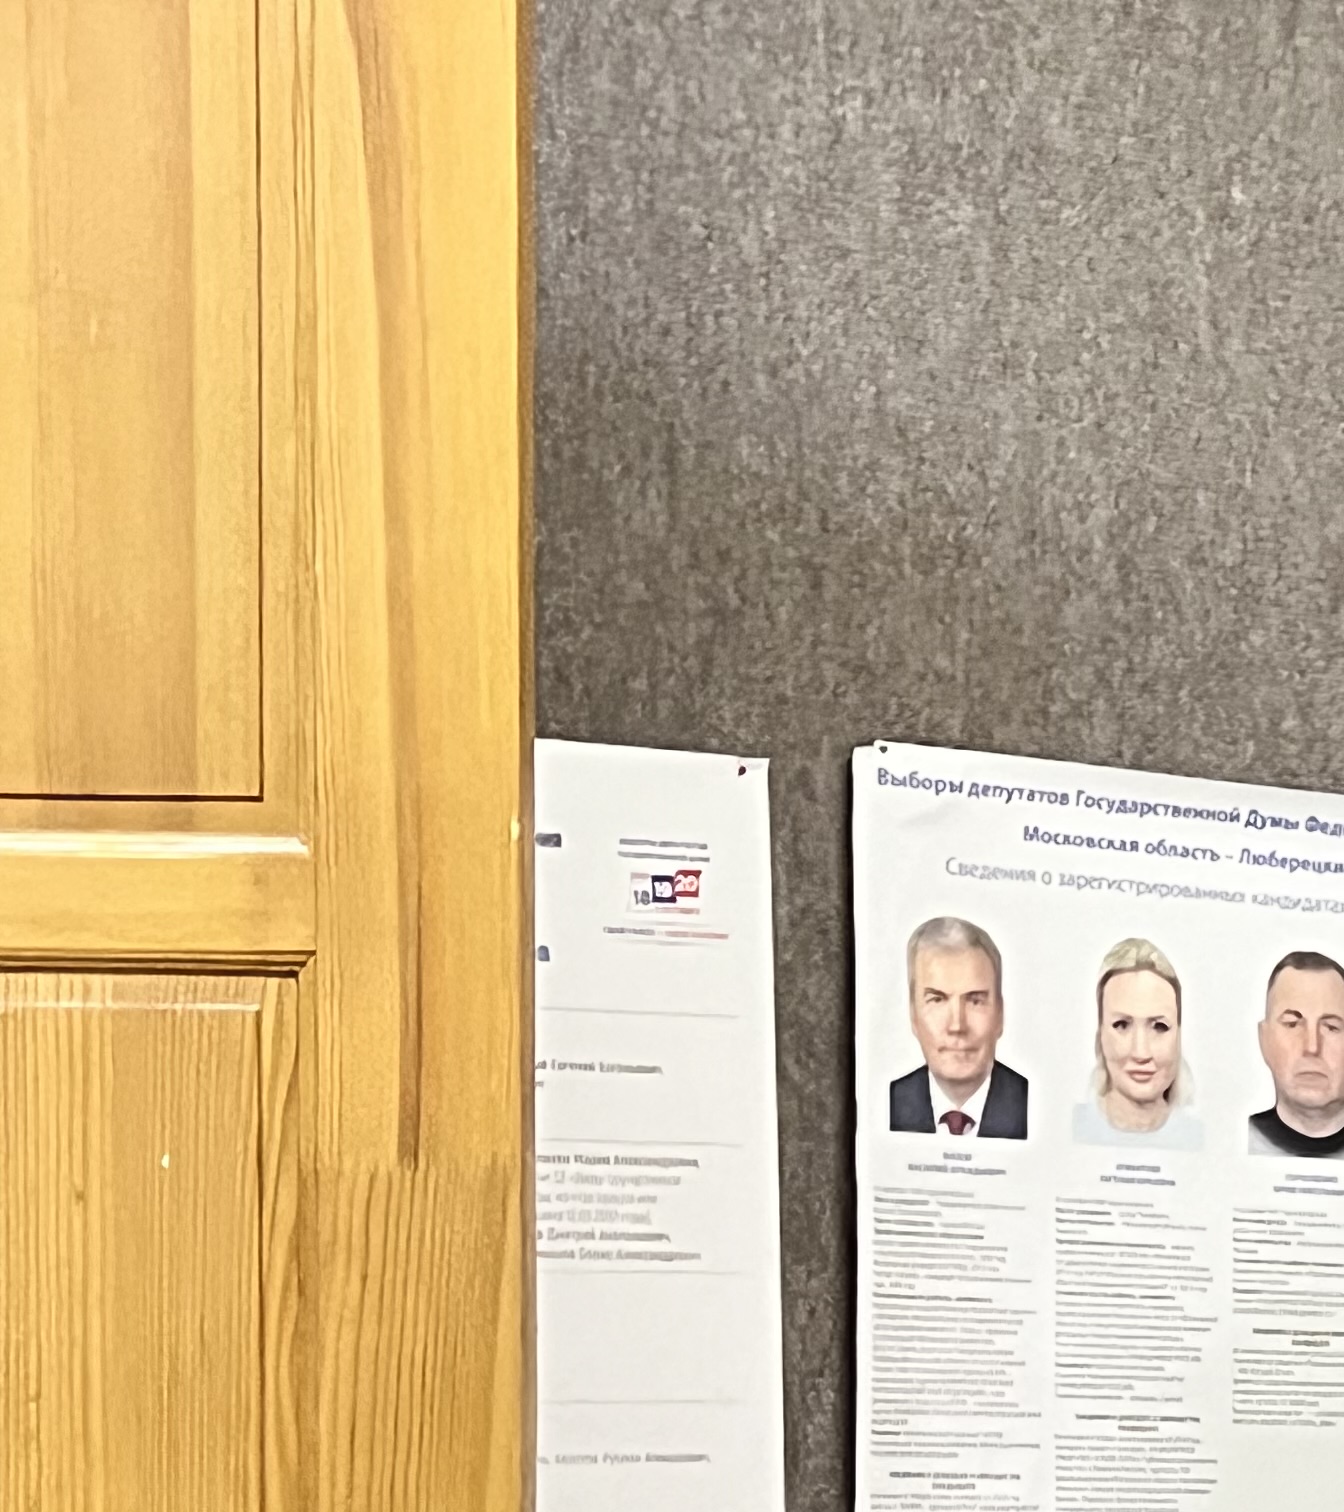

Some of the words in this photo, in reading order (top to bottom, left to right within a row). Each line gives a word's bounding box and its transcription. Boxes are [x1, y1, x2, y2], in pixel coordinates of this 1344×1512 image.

[878, 767, 963, 796] Выборы
[968, 782, 1070, 806] депутатов
[1075, 789, 1241, 823] Государственной
[1244, 809, 1300, 830] Думы
[1023, 826, 1139, 853] Московская
[1144, 839, 1220, 861] область
